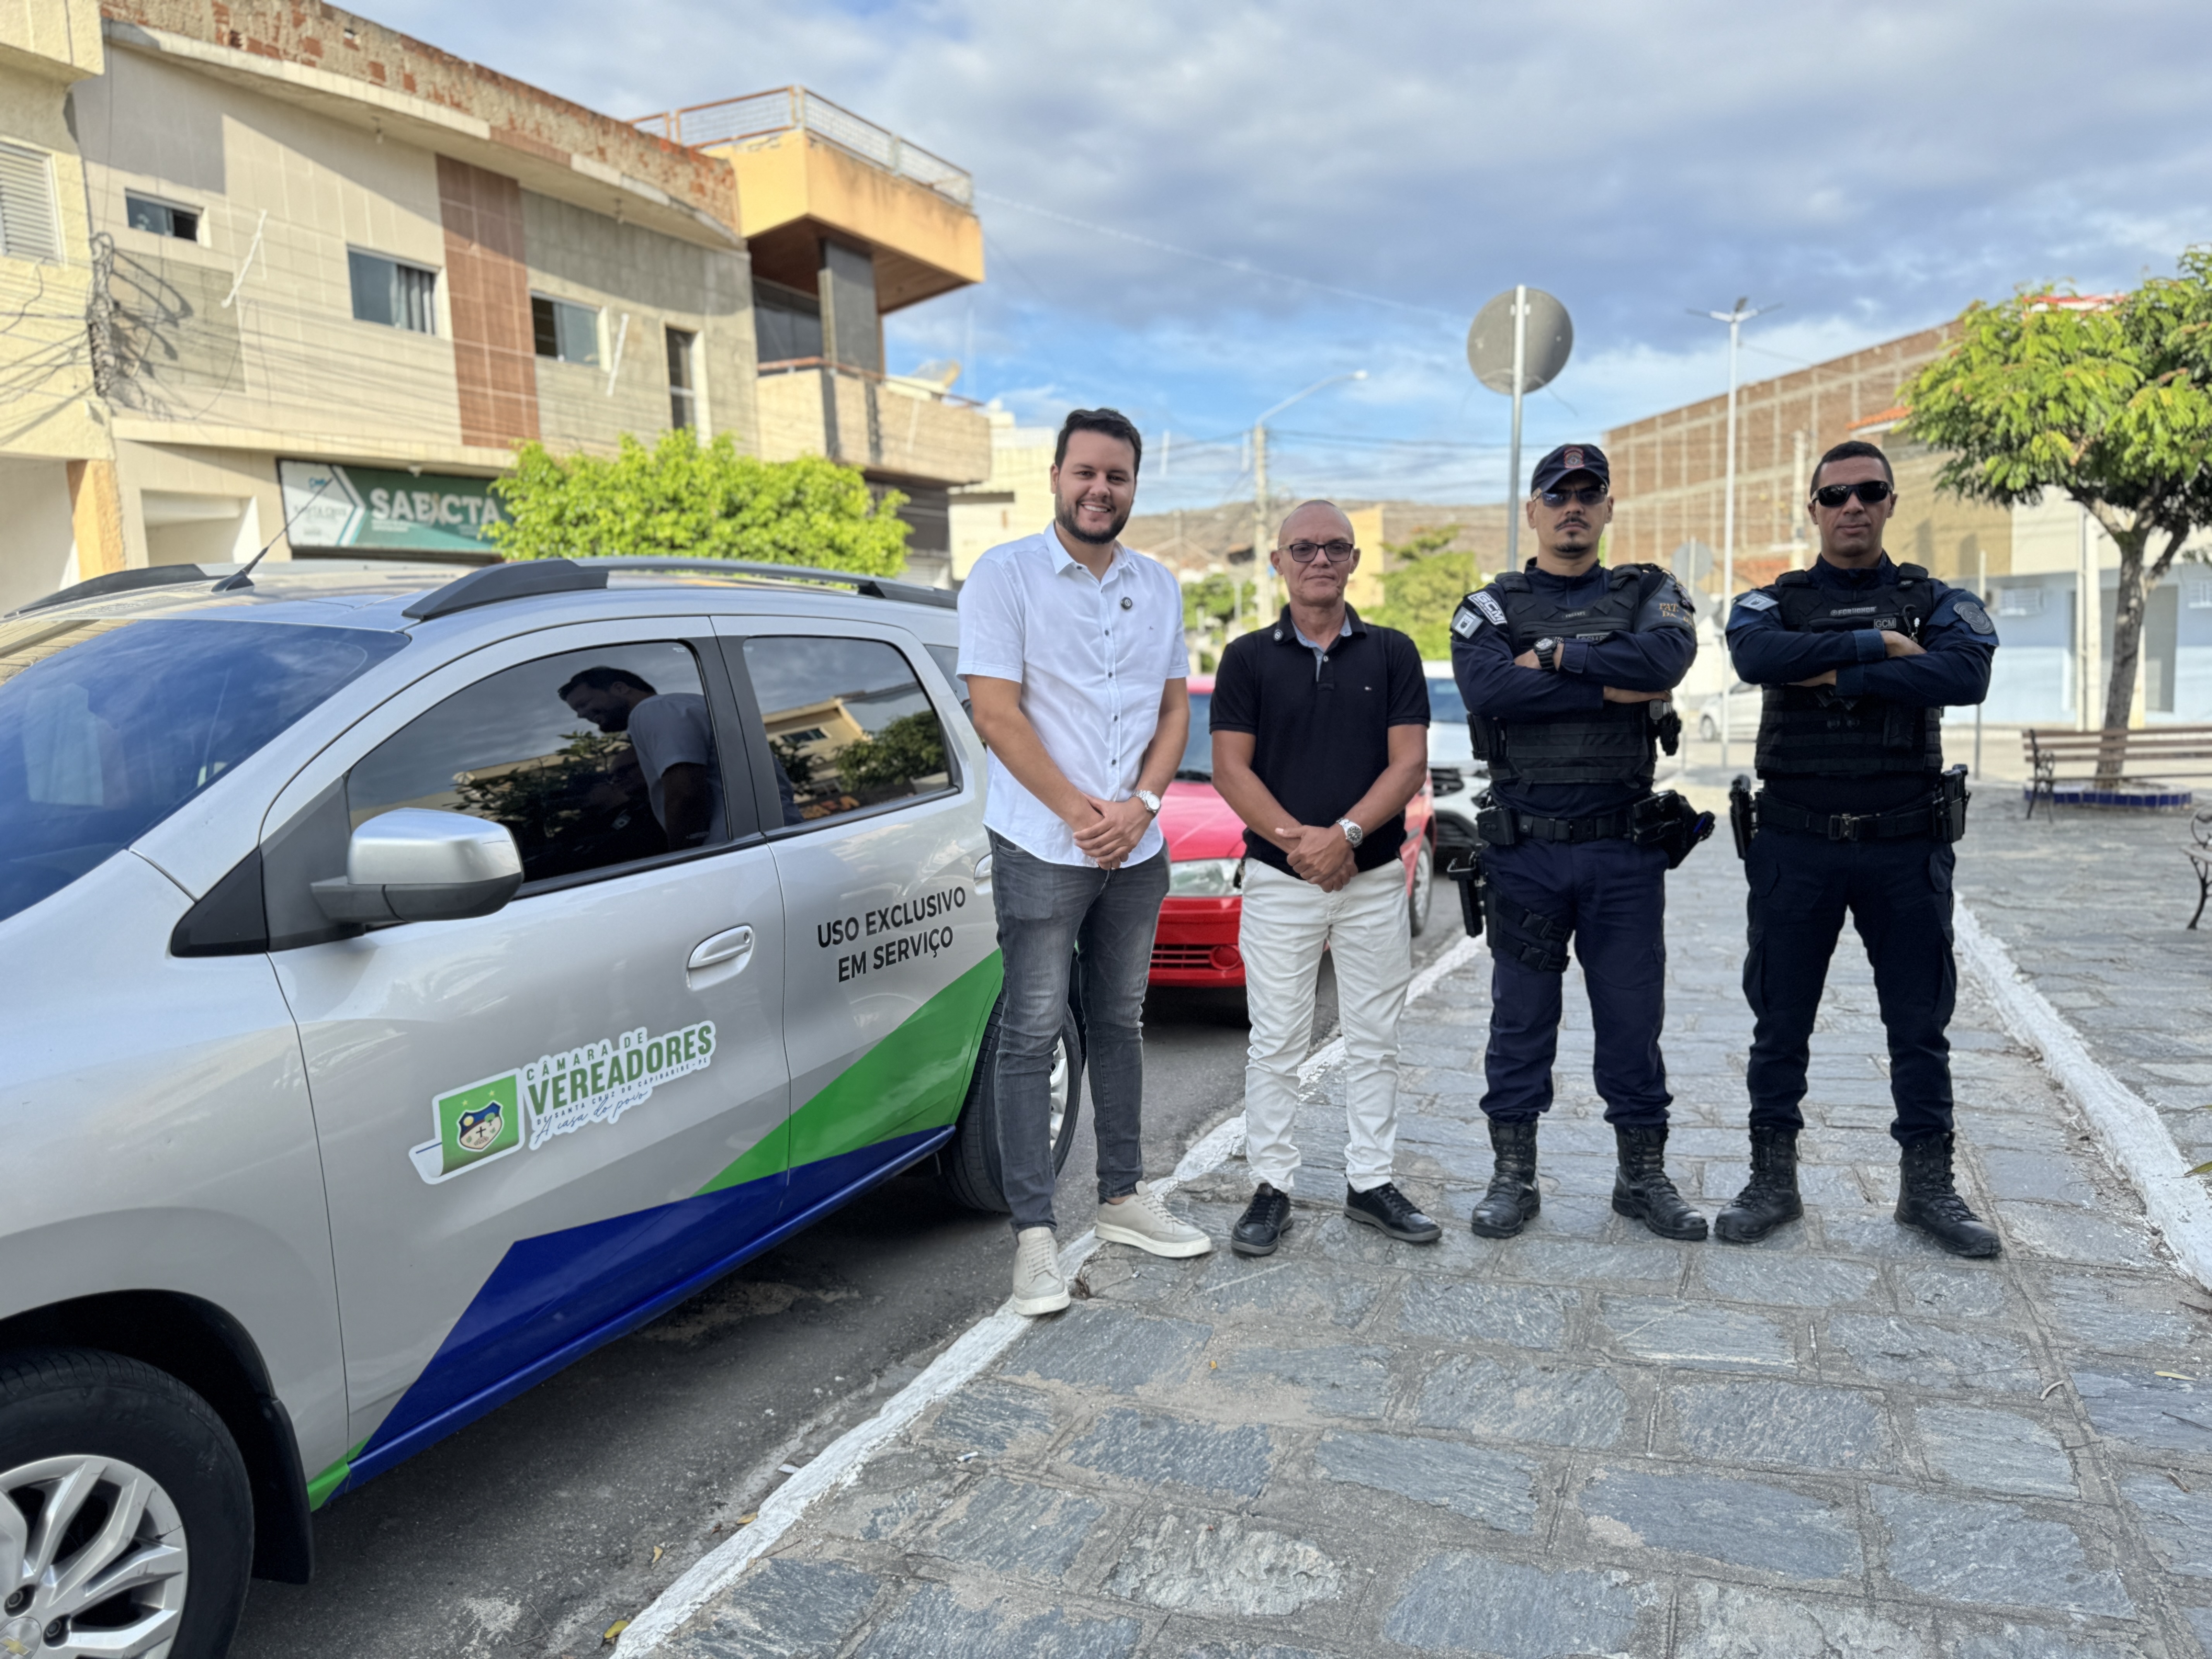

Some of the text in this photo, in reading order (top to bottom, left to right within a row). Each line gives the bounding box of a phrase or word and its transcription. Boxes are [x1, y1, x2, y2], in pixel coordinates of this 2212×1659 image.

[1476, 594, 1504, 621] GCM
[1875, 619, 1895, 628] GCM
[817, 886, 966, 948] USO EXCLUSIVO
[838, 926, 953, 983] EM SERVIÇO
[527, 1032, 643, 1081] CÂMARA DE
[527, 1025, 712, 1116] VEREADORES
[534, 1091, 648, 1144] A casa do povo
[537, 1116, 547, 1125] DE
[555, 1103, 585, 1118] SANTA
[592, 1091, 615, 1104] CRUZ
[622, 1085, 632, 1093] DO
